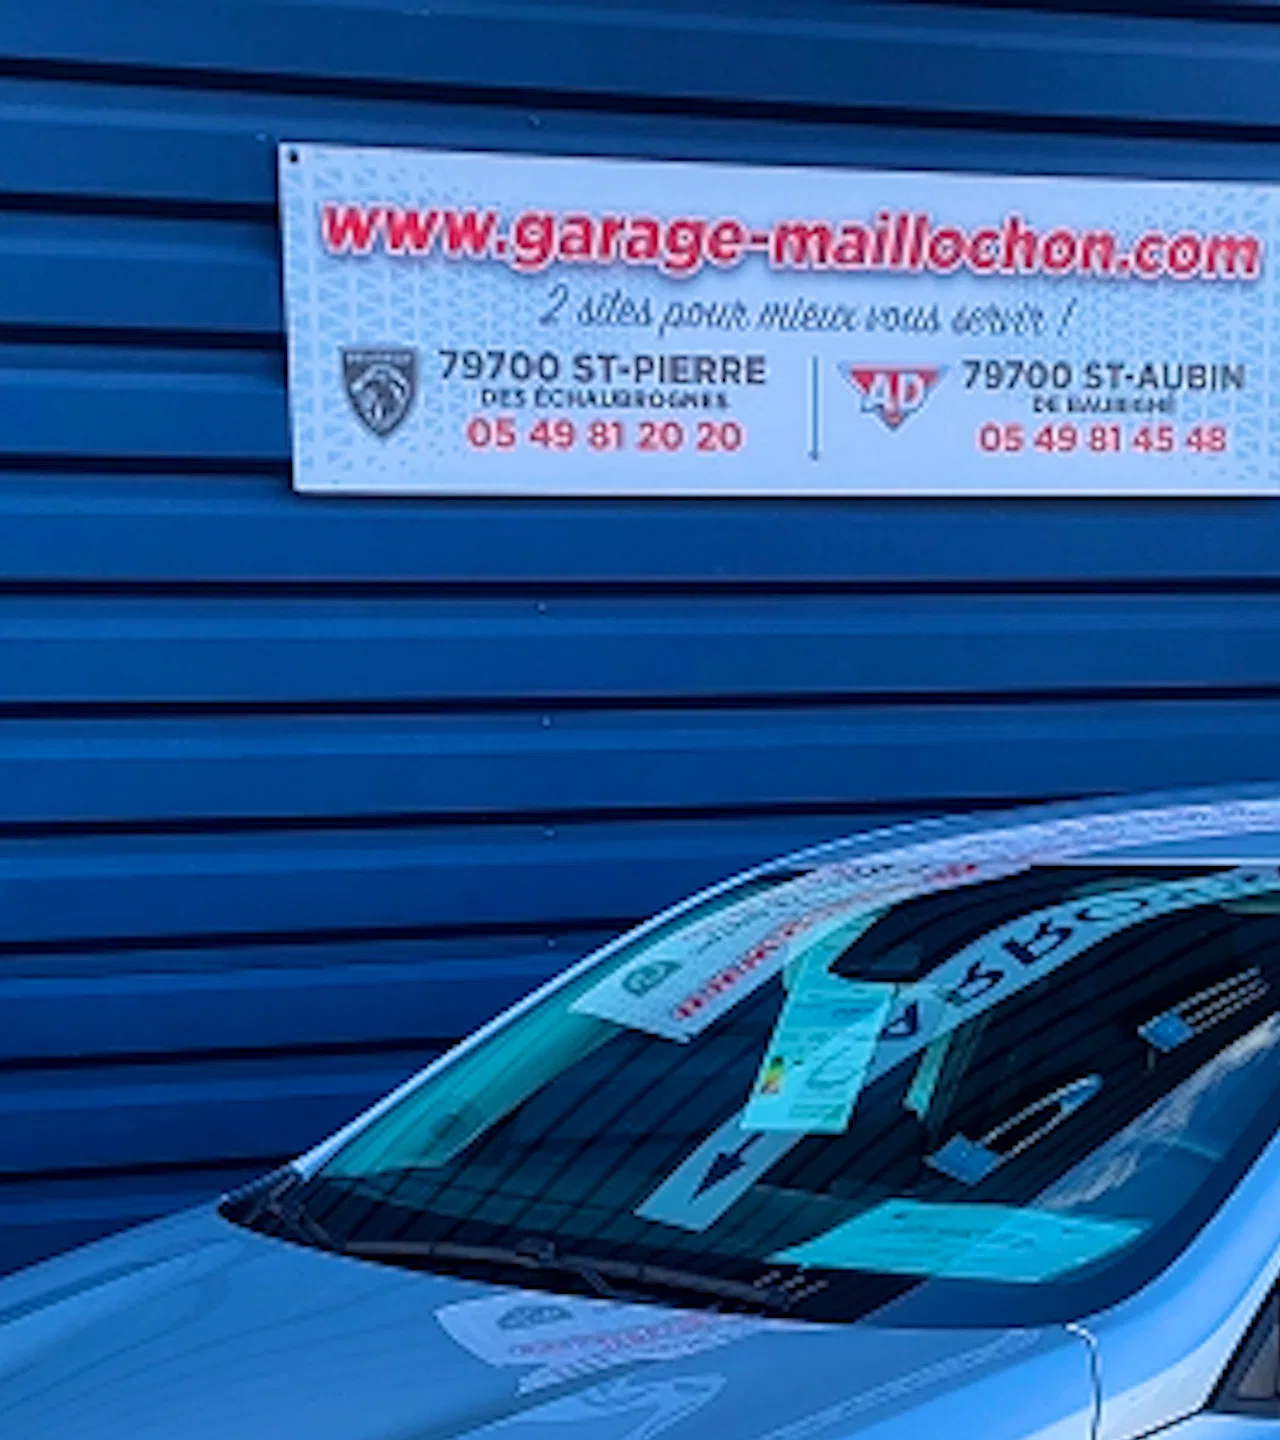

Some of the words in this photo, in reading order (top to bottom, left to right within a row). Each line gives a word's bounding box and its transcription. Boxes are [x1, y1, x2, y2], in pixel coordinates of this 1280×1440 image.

[322, 202, 1261, 274] www.garage-maillochon.com
[538, 283, 569, 326] 2
[577, 290, 651, 327] sites
[657, 300, 750, 339] pour
[757, 297, 857, 332] mieux
[865, 303, 941, 333] vous
[439, 350, 560, 383] 79700
[572, 353, 767, 386] ST-PIERRE
[962, 359, 1072, 390] 79700
[1083, 361, 1246, 392] ST-AUBIN
[481, 387, 525, 409] DES
[467, 416, 516, 448] 05
[529, 417, 575, 449] 49
[588, 419, 624, 450] 81
[637, 420, 684, 451] 20
[696, 421, 742, 452] 20
[979, 421, 1024, 452] 05
[1034, 422, 1077, 453] 49
[1087, 424, 1121, 453] 81
[1132, 425, 1174, 453] 45
[1185, 425, 1227, 454] 48
